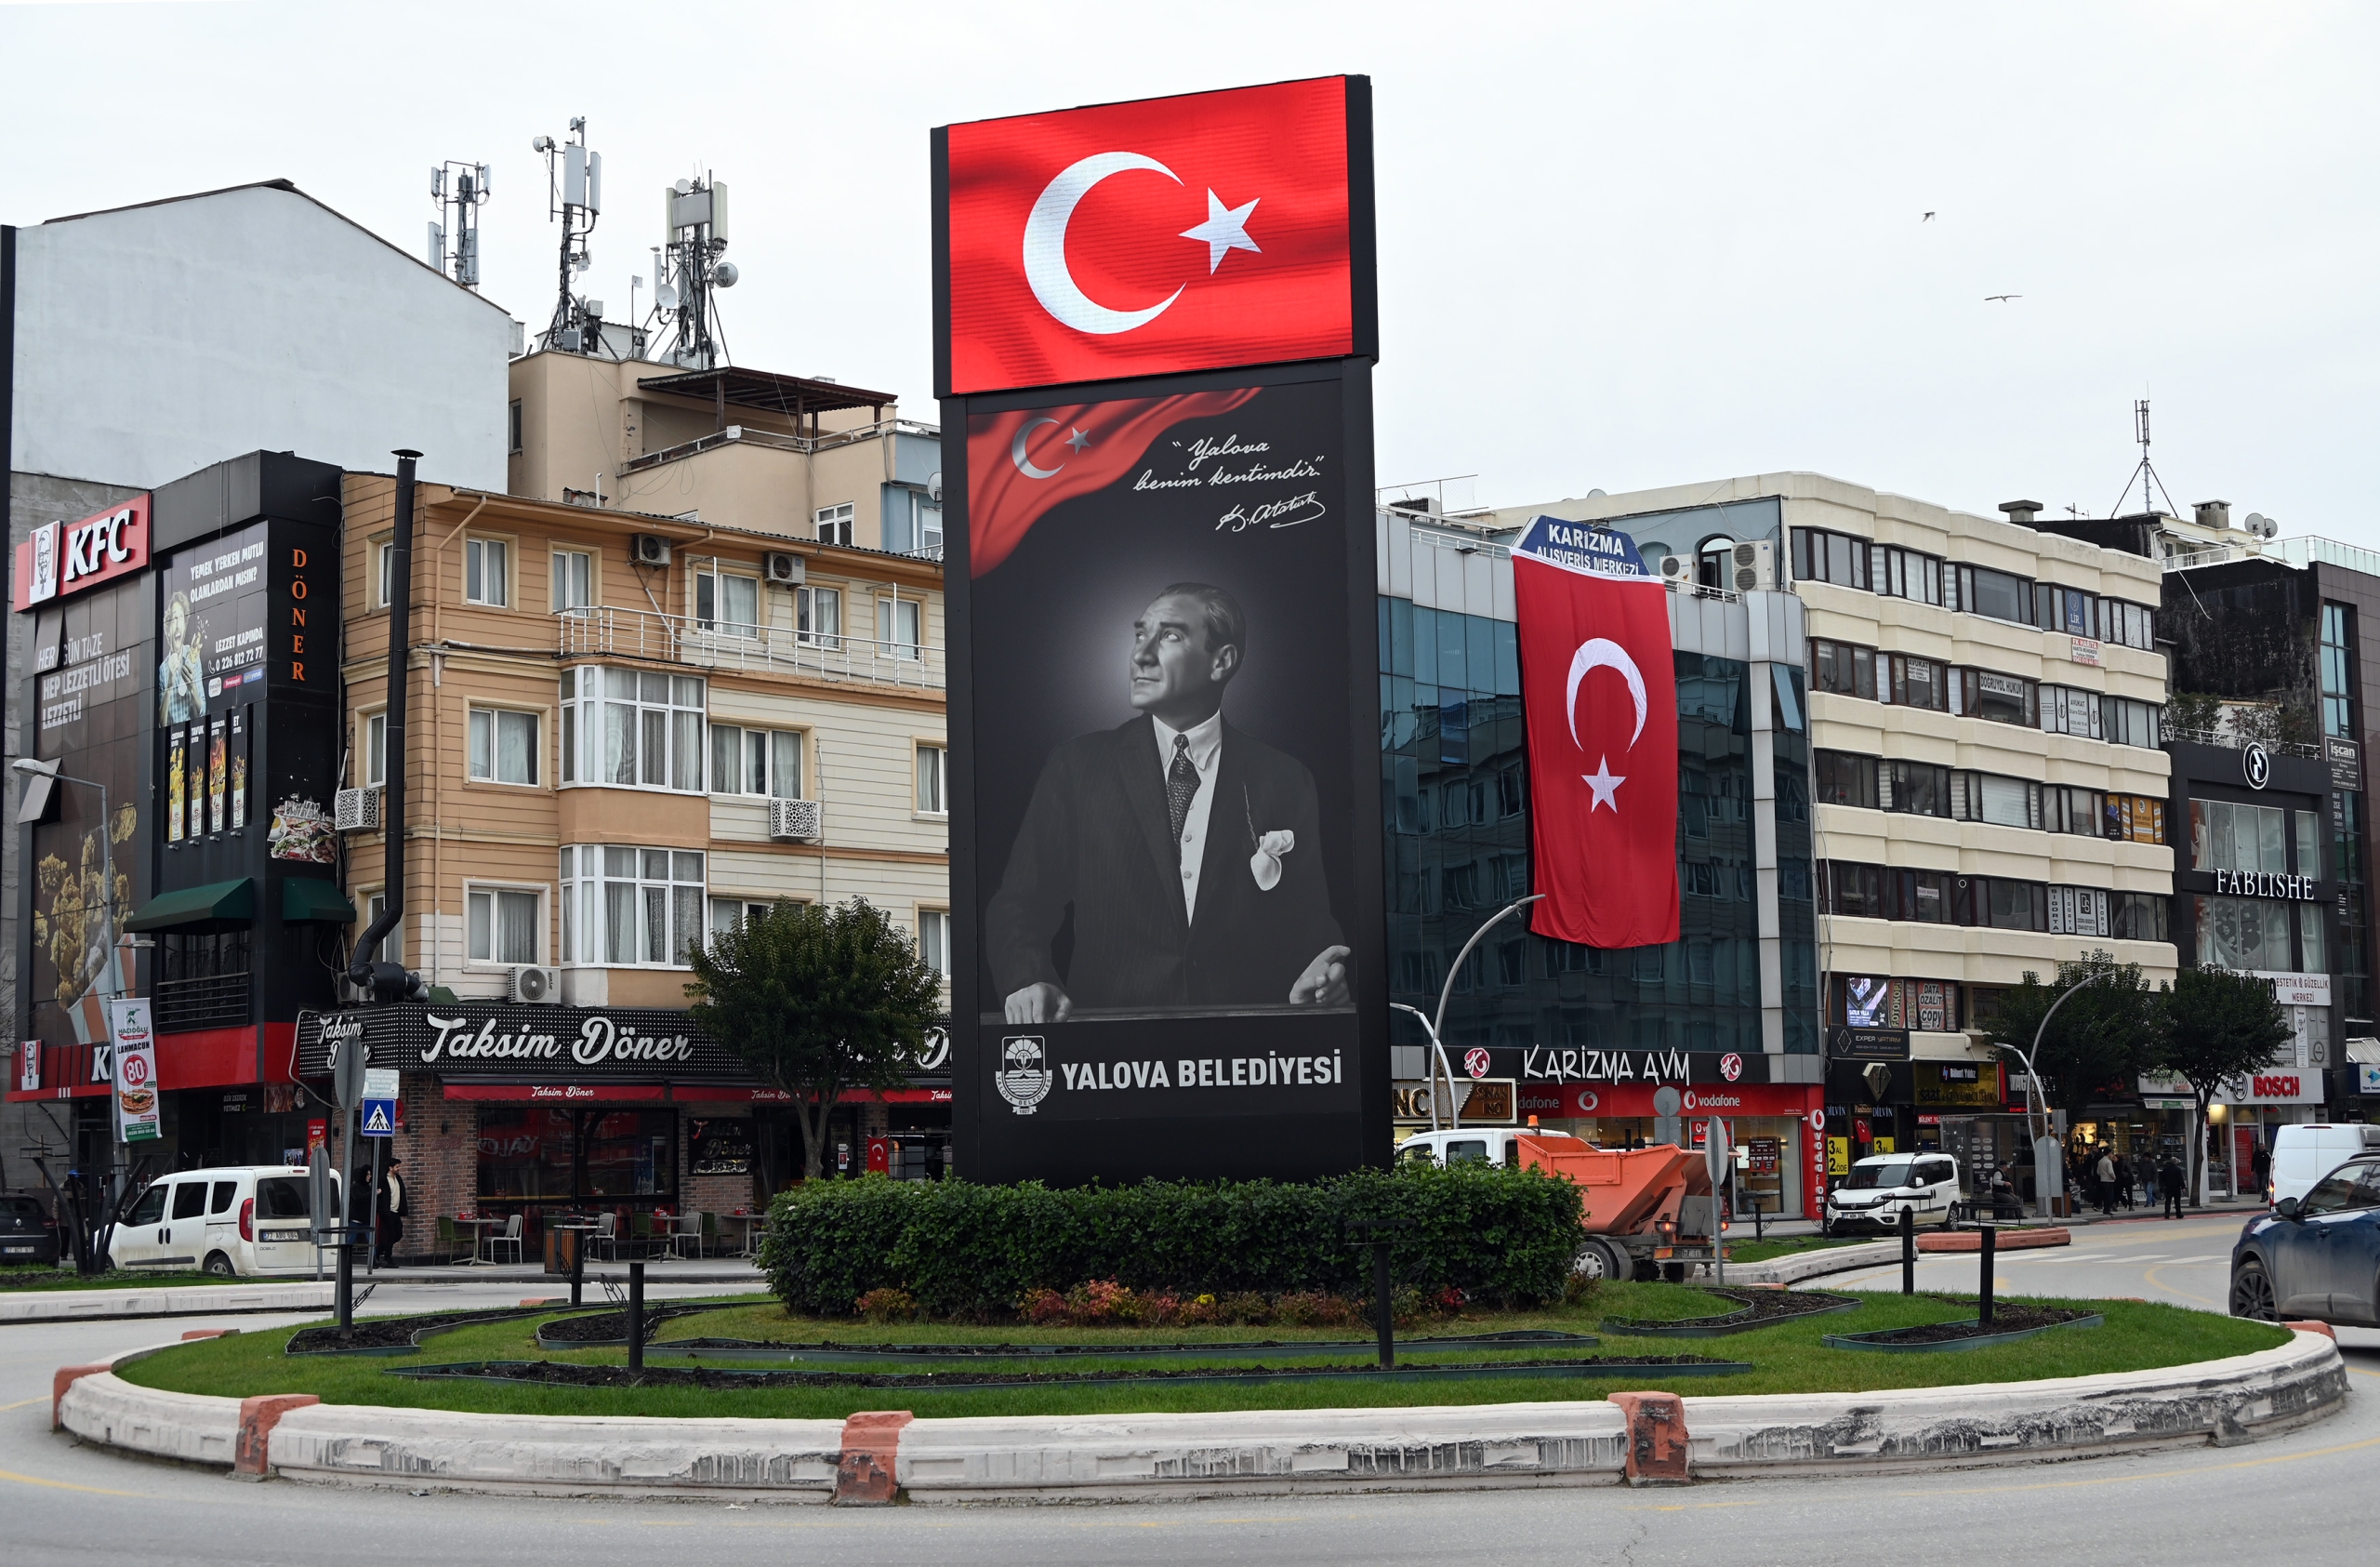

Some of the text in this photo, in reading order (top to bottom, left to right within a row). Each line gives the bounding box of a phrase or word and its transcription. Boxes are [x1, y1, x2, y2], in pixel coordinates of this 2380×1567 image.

[1133, 469, 1201, 492] benim
[64, 510, 133, 582] KFC
[191, 541, 264, 580] YEMEK YERKEN MUTLU
[1593, 556, 1639, 576] MERKEZİ
[191, 575, 233, 604] OLANLARDAN
[292, 548, 307, 682] DÖNER
[216, 627, 263, 653] LEZZET KAPINDA
[38, 646, 56, 671] HER
[82, 632, 103, 659] TAZE
[216, 645, 263, 671] 0 226 812 72 77
[43, 648, 130, 700] HEP LEZZETLİ ÖTESİ
[1909, 658, 1928, 669] AVUKAT
[2005, 680, 2023, 696] HUKUK
[43, 692, 81, 730] LEZZETLİ
[2330, 741, 2355, 757] işcan
[2215, 868, 2314, 900] FABLISHE
[1924, 985, 1939, 994] DATA
[2276, 976, 2297, 988] ESTETİK
[2304, 976, 2329, 989] GÜZELLİK
[2292, 991, 2315, 1003] MERKEZİ
[118, 1026, 149, 1034] HACIOĞLU
[317, 1015, 364, 1044] Taksim
[421, 1013, 562, 1063] Taksim
[571, 1016, 693, 1065] Döner
[117, 1041, 150, 1055] LAHMACUN
[1061, 1049, 1342, 1091] YALOVA BELEDİYESİ
[1524, 1043, 1690, 1087] KARİZMA AVM
[531, 1085, 595, 1097] Taksim Döner
[751, 1089, 776, 1101] Taksim
[1920, 1087, 1941, 1102] saat
[2253, 1075, 2300, 1097] BOSCH
[1517, 1096, 1560, 1109] dafone
[1699, 1095, 1740, 1108] vodafone
[1872, 1105, 1893, 1117] DİLVİN
[1829, 1140, 1836, 1155] 3
[1814, 1132, 1824, 1214] vodafone
[1829, 1158, 1847, 1172] 2 ÖDE
